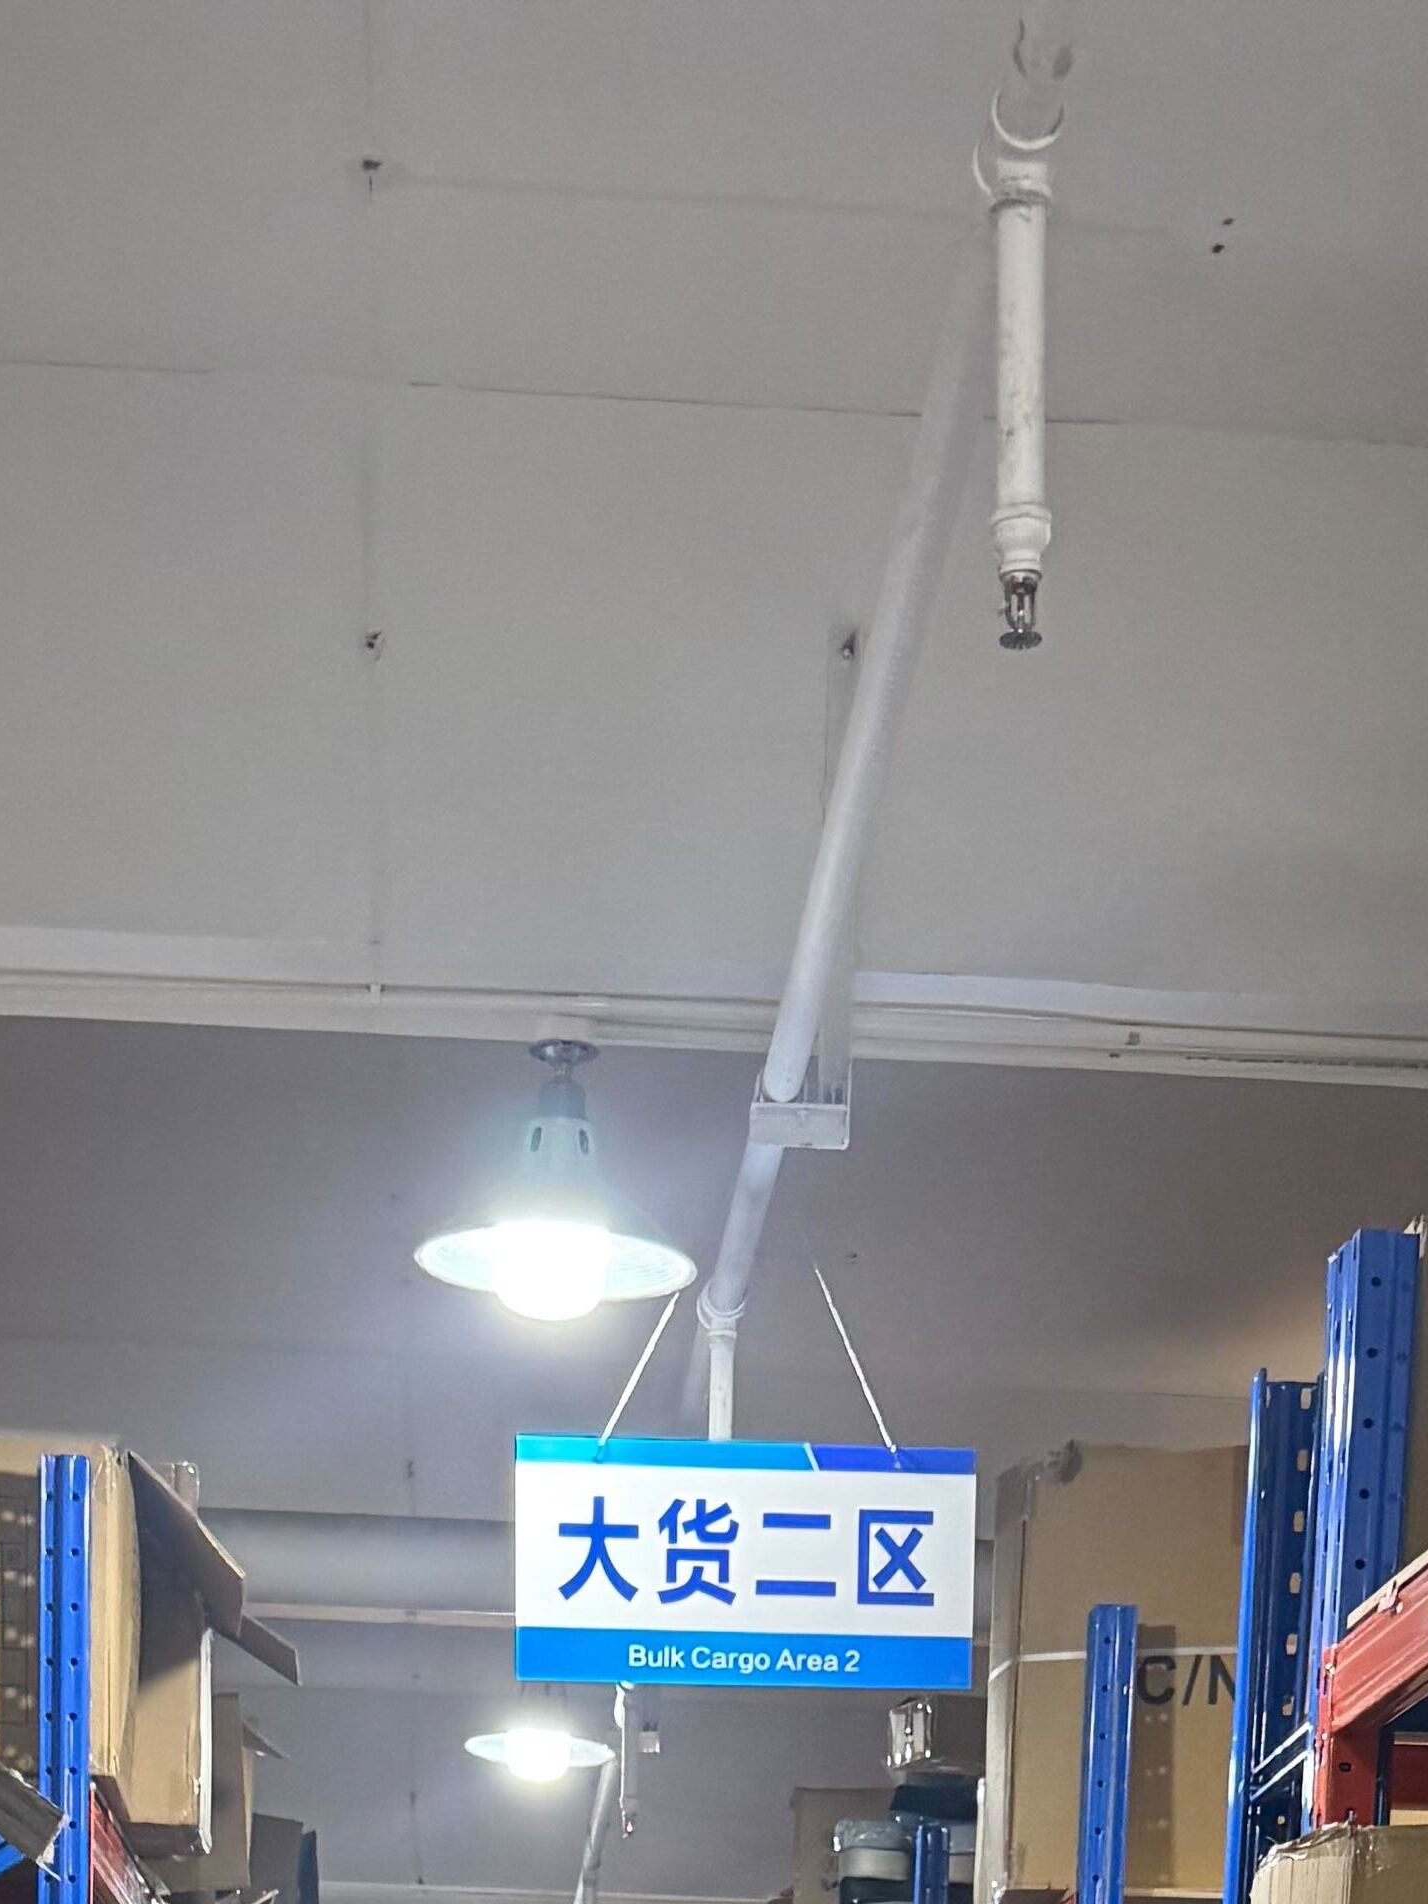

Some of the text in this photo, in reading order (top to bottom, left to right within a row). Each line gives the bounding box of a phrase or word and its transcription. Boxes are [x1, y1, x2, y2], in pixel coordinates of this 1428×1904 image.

[558, 1496, 934, 1607] 大货二区
[628, 1645, 861, 1674] Bulk Cargo Area 2
